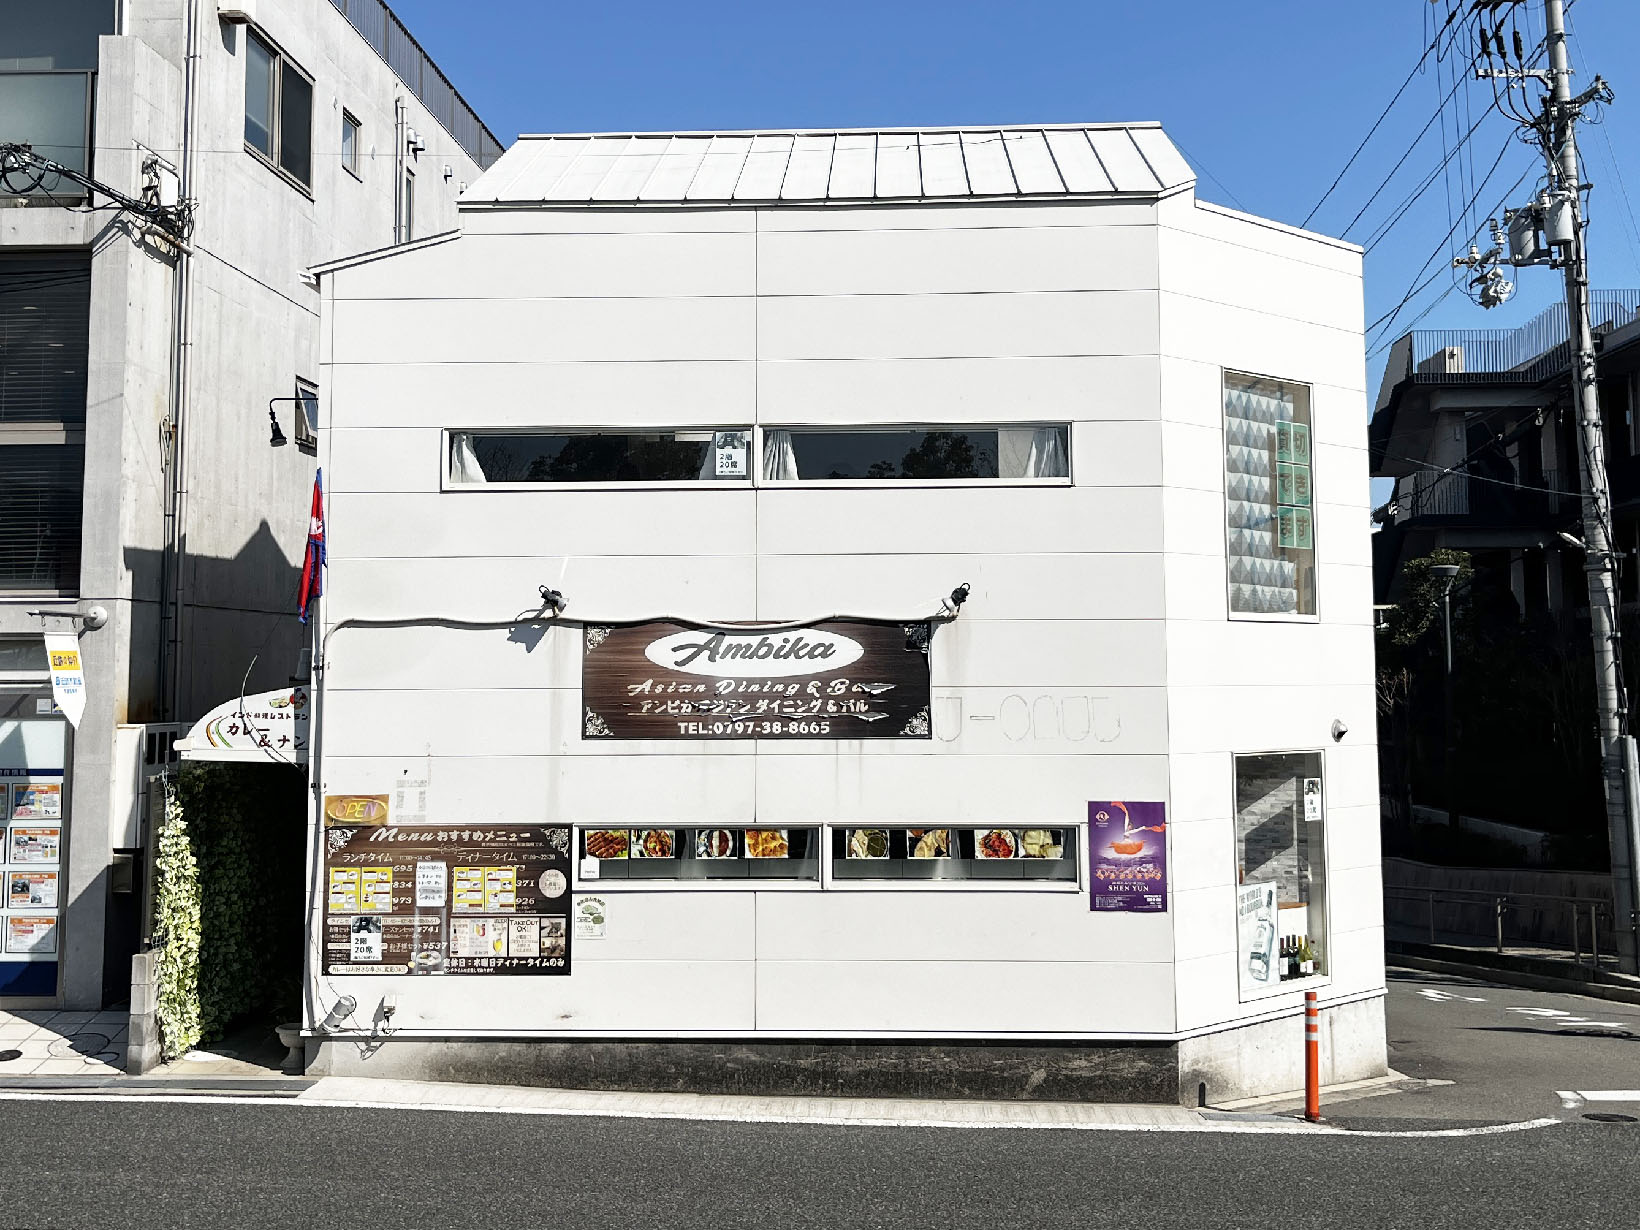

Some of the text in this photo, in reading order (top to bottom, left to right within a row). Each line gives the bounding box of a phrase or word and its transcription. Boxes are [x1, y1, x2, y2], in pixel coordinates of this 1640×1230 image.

[672, 631, 835, 667] Ambika
[627, 679, 707, 696] Asian
[715, 680, 801, 697] Dining
[807, 681, 821, 697] &
[227, 722, 270, 736] カレー
[678, 721, 830, 734] TEL:0797-38-8665
[277, 735, 306, 749] ナン
[336, 802, 380, 817] OPEN
[369, 828, 530, 842] Menu おすすめメニュー
[342, 853, 393, 863] ランチタイム
[456, 852, 517, 862] ディナータイム
